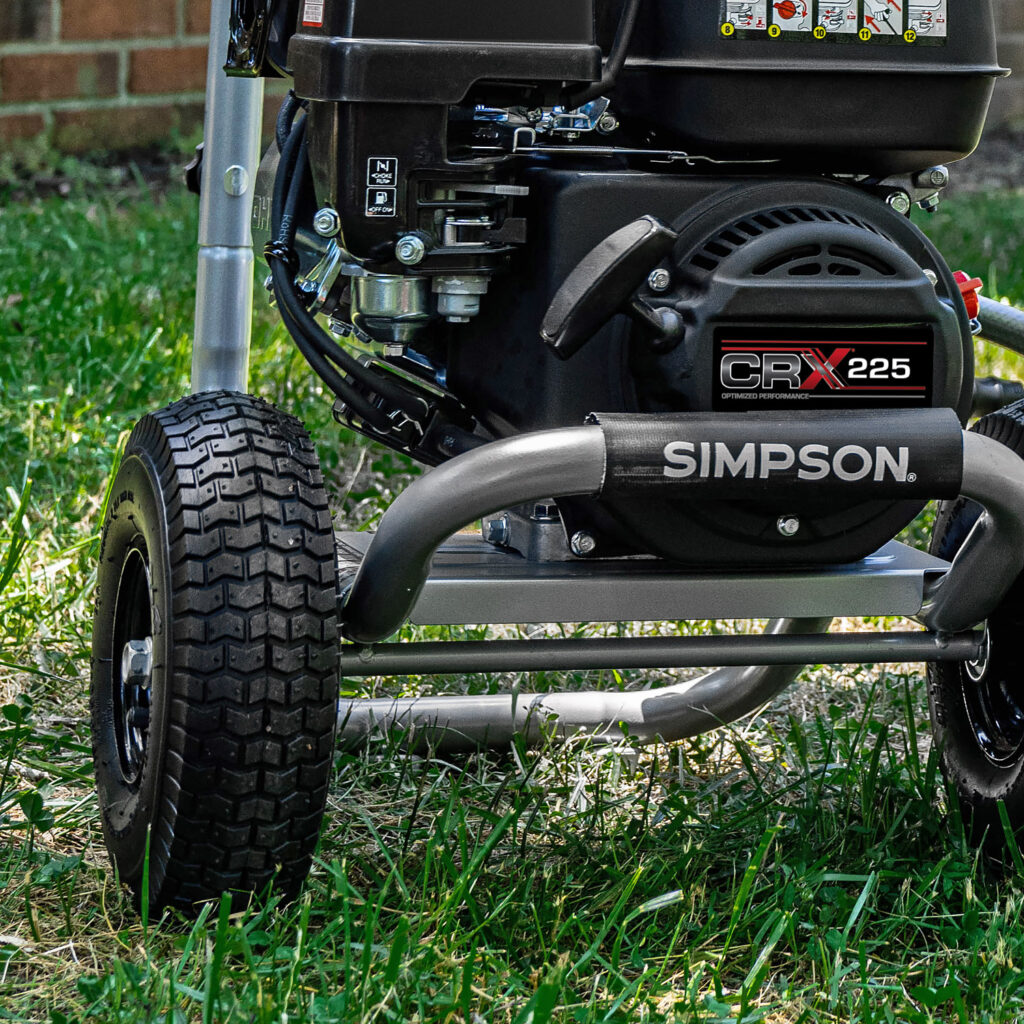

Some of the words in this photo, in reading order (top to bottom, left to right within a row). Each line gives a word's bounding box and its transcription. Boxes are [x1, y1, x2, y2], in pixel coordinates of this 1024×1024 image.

[815, 28, 825, 37] 10
[860, 30, 869, 39] 11
[905, 32, 915, 41] 12
[720, 348, 850, 390] CRX
[847, 357, 911, 380] 225
[721, 392, 758, 400] OPTIMIZED
[758, 392, 810, 400] PERFORMANCE
